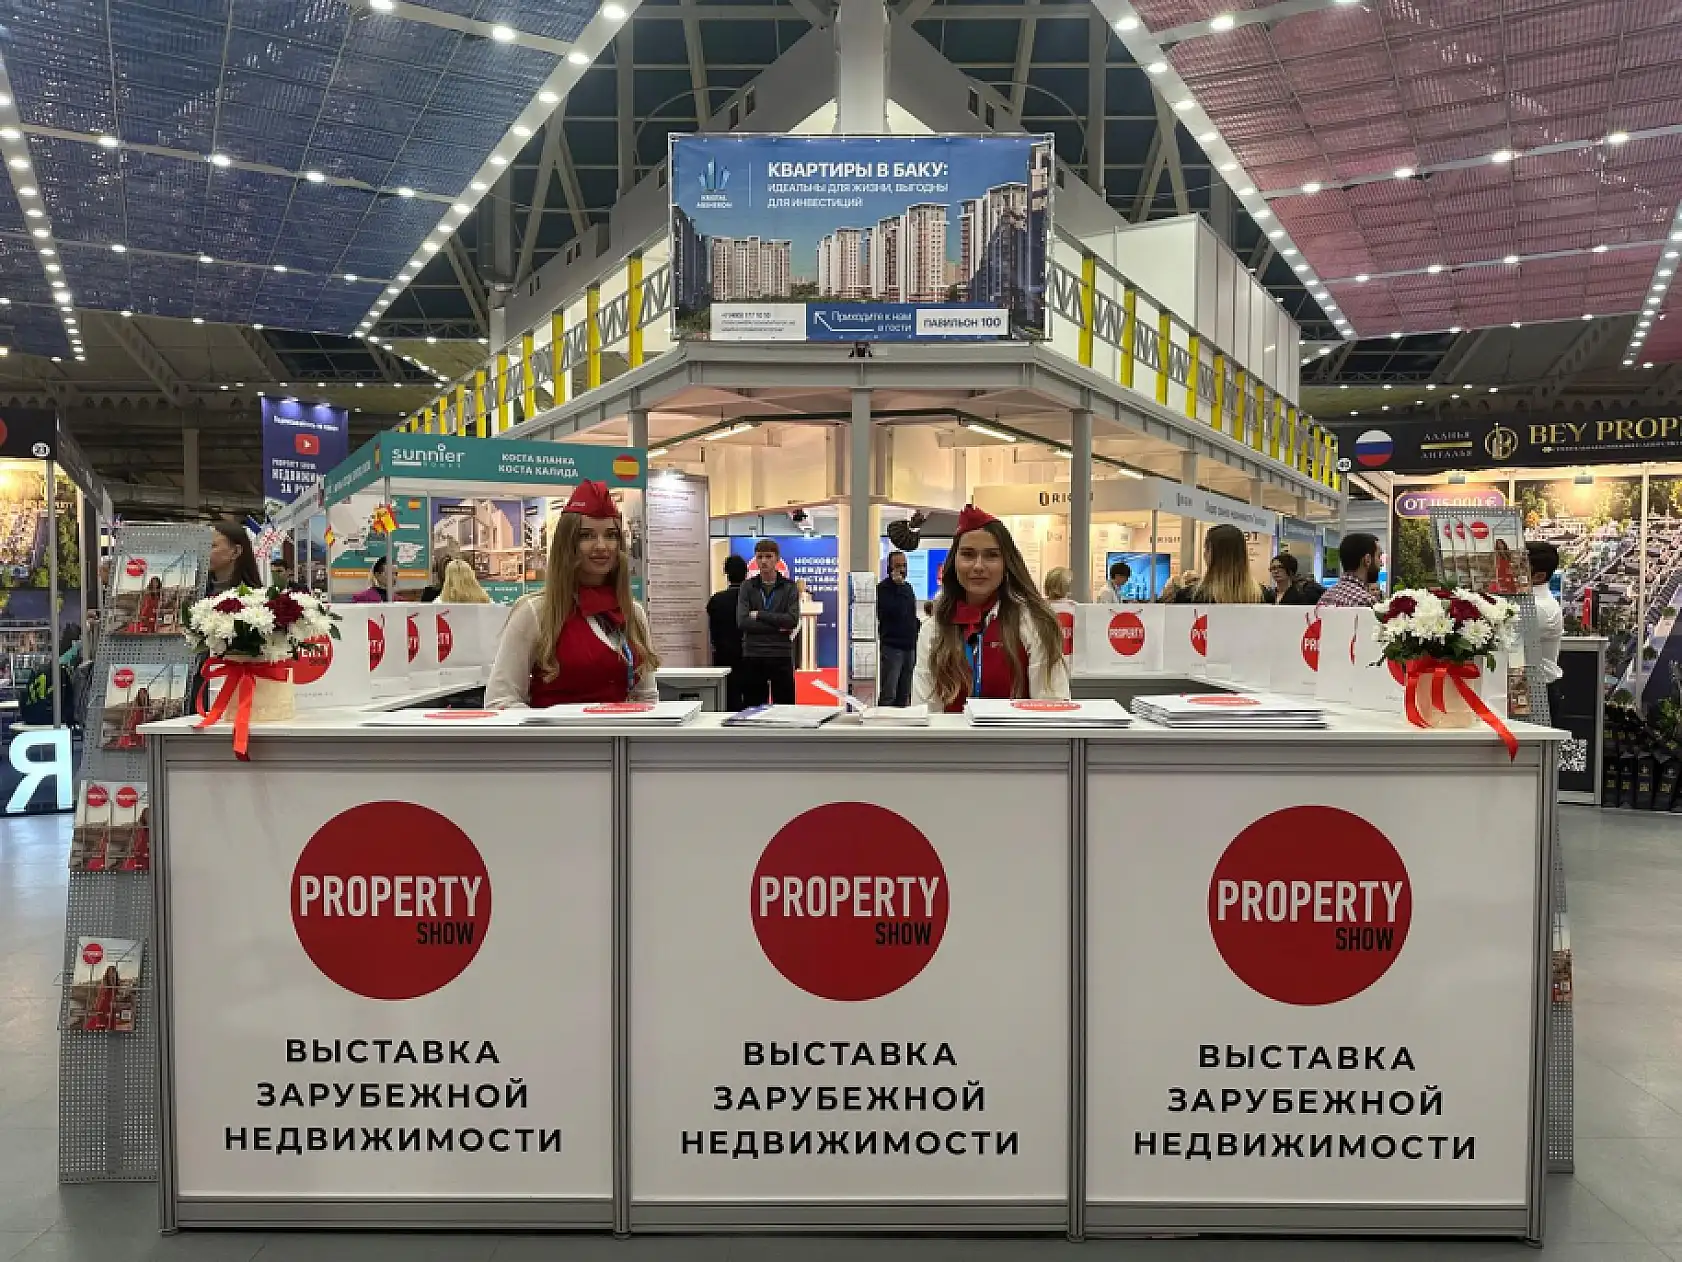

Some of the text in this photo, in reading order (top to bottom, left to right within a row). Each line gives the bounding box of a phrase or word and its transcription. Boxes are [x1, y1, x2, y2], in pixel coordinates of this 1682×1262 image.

[767, 162, 949, 178] КВАРТИРЫ В БАКУ:
[767, 183, 827, 194] ИДЕАЛЬНЫ
[828, 184, 850, 194] ДЛЯ
[896, 183, 949, 194] ВЫГОДНЫ
[767, 197, 863, 209] ДЛЯ ИНВЕСТИЦИЙ
[831, 311, 884, 323] Приходите
[923, 317, 1002, 328] ПАВИЛЬОН 100
[1528, 416, 1682, 444] BEY PROP
[391, 443, 466, 462] sunnier
[502, 453, 575, 465] КОСТА БЛАНКА
[499, 464, 579, 477] КОСТА КАЛИДА
[1404, 498, 1427, 511] ОТ
[298, 875, 482, 917] PROPERTY
[757, 876, 940, 918] PROPERTY
[1217, 880, 1403, 922] PROPERTY
[416, 921, 474, 945] SHOW
[875, 921, 933, 945] SHOW
[1335, 926, 1394, 951] SHOW
[286, 1039, 500, 1064] ВЫСТАВКА
[744, 1041, 958, 1066] ВЫСТАВКА
[1199, 1044, 1416, 1071] ВЫСТАВКА
[256, 1077, 528, 1109] ЗАРУБЕЖНОЙ
[713, 1080, 984, 1112] ЗАРУБЕЖНОЙ
[1166, 1084, 1442, 1116] ЗАРУБЕЖНОЙ
[225, 1126, 562, 1156] НЕДВИЖИМОСТИ
[682, 1130, 1019, 1160] НЕДВИЖИМОСТИ
[1134, 1131, 1475, 1162] НЕДВИЖИМОСТИ
